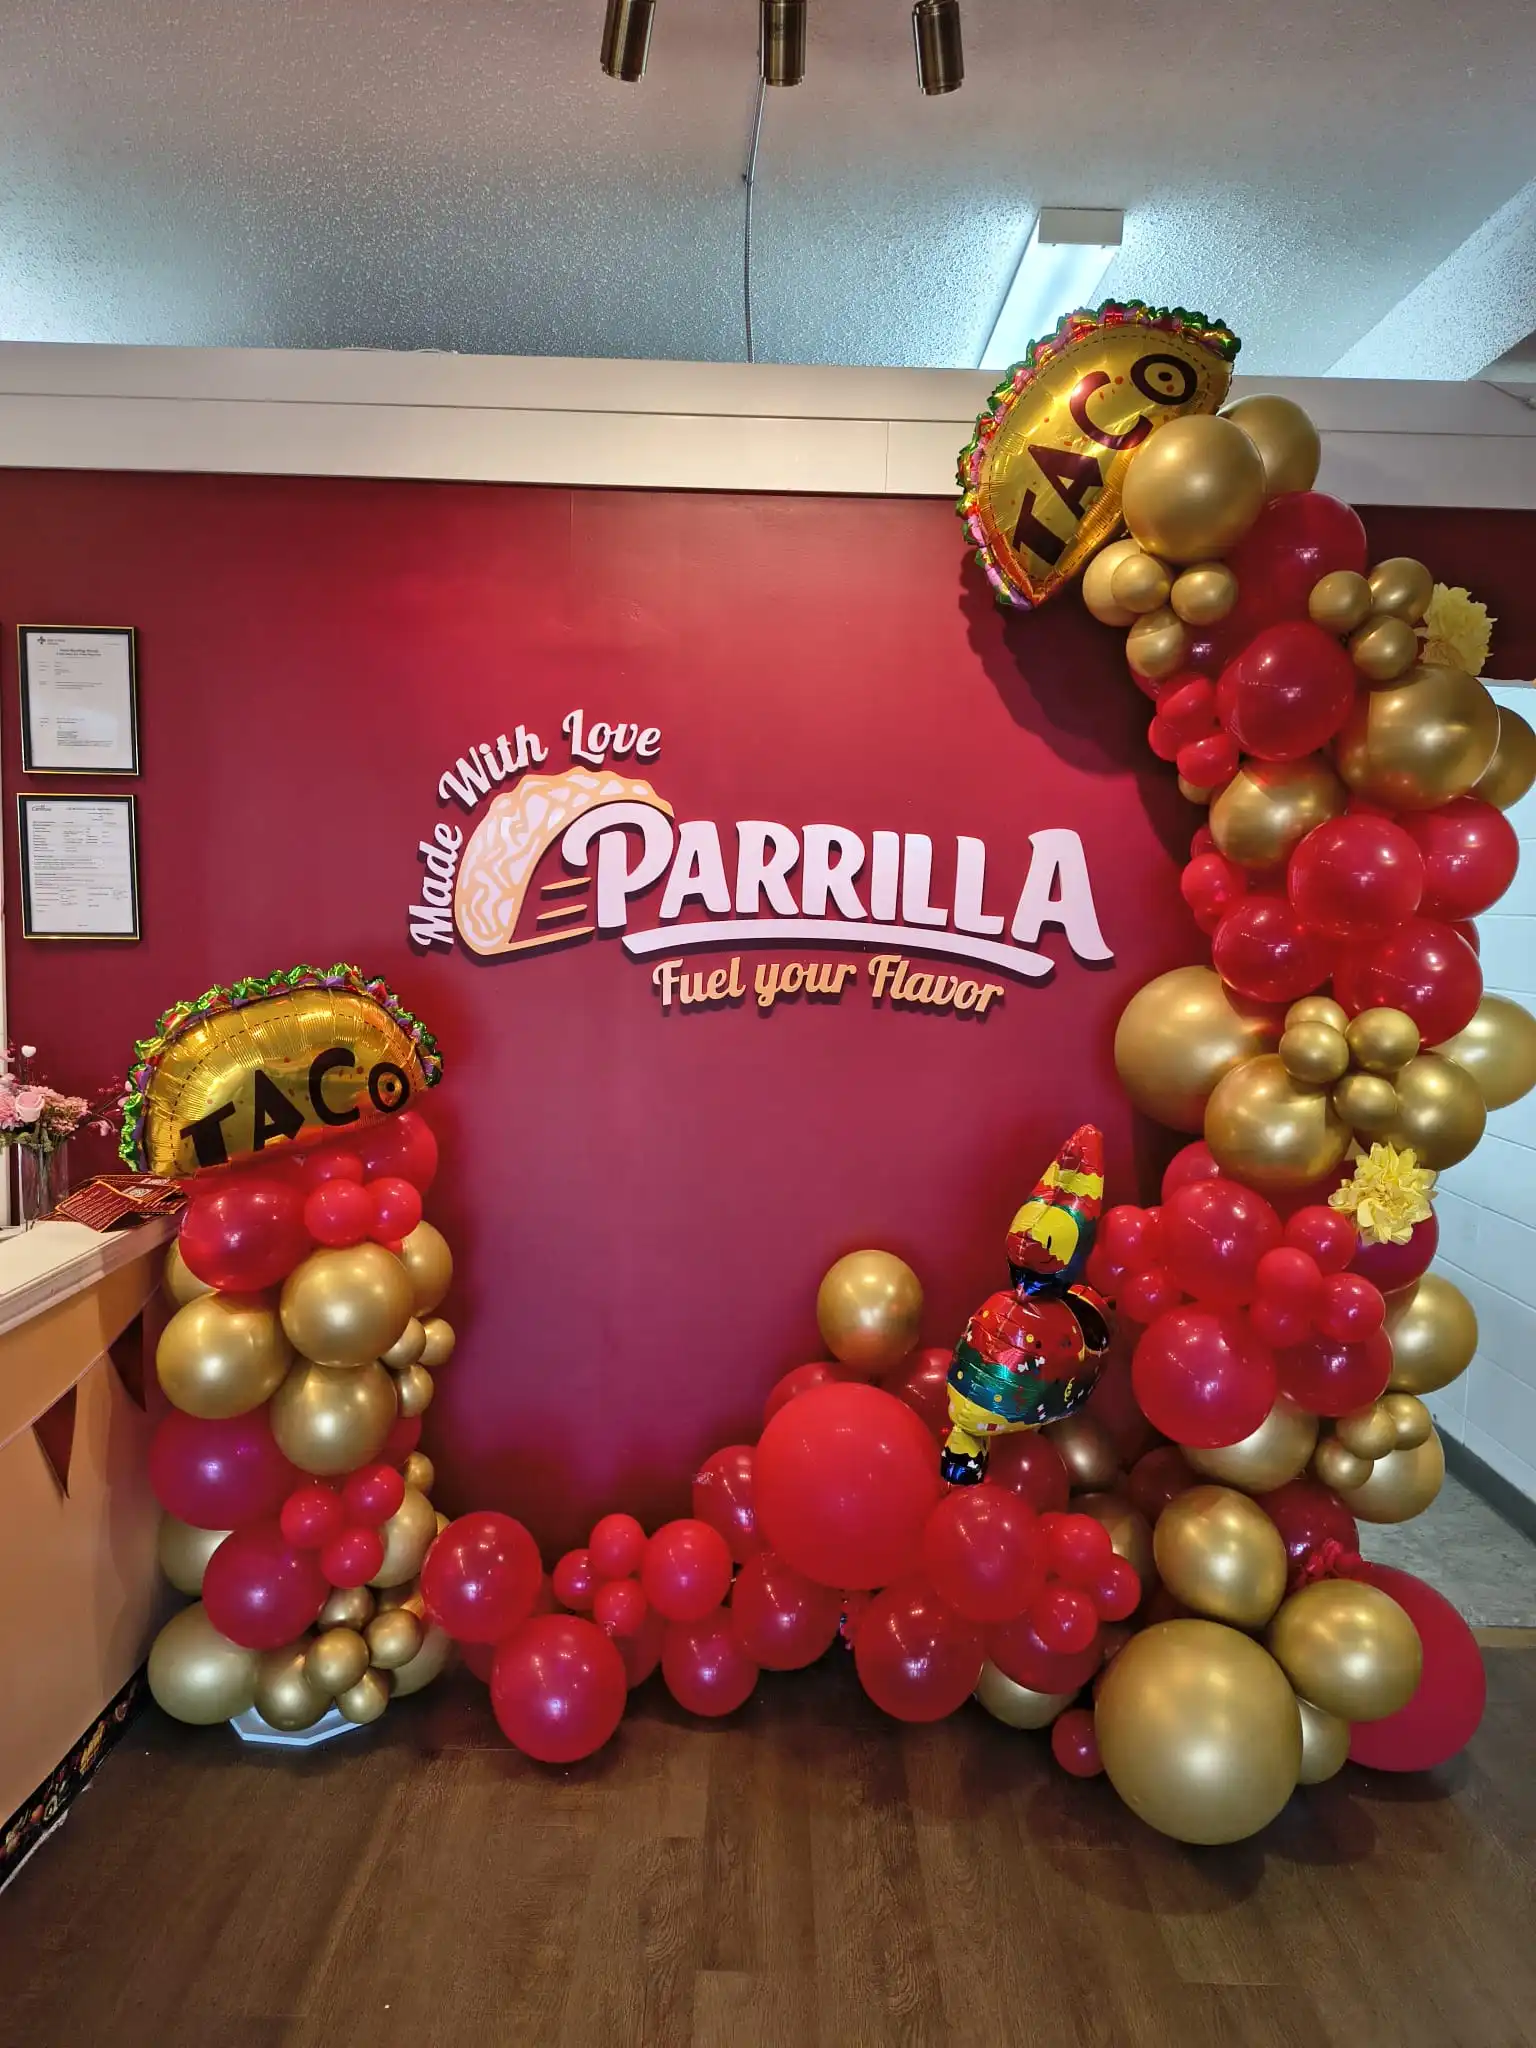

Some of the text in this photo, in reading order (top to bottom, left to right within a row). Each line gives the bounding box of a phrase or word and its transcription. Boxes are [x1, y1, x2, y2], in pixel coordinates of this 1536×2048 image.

[1012, 353, 1198, 566] TACO
[409, 709, 662, 945] Made With Love
[562, 802, 1115, 961] PARRILLA
[652, 954, 1005, 1012] Fuel your Flavor
[180, 1047, 410, 1167] TACO
